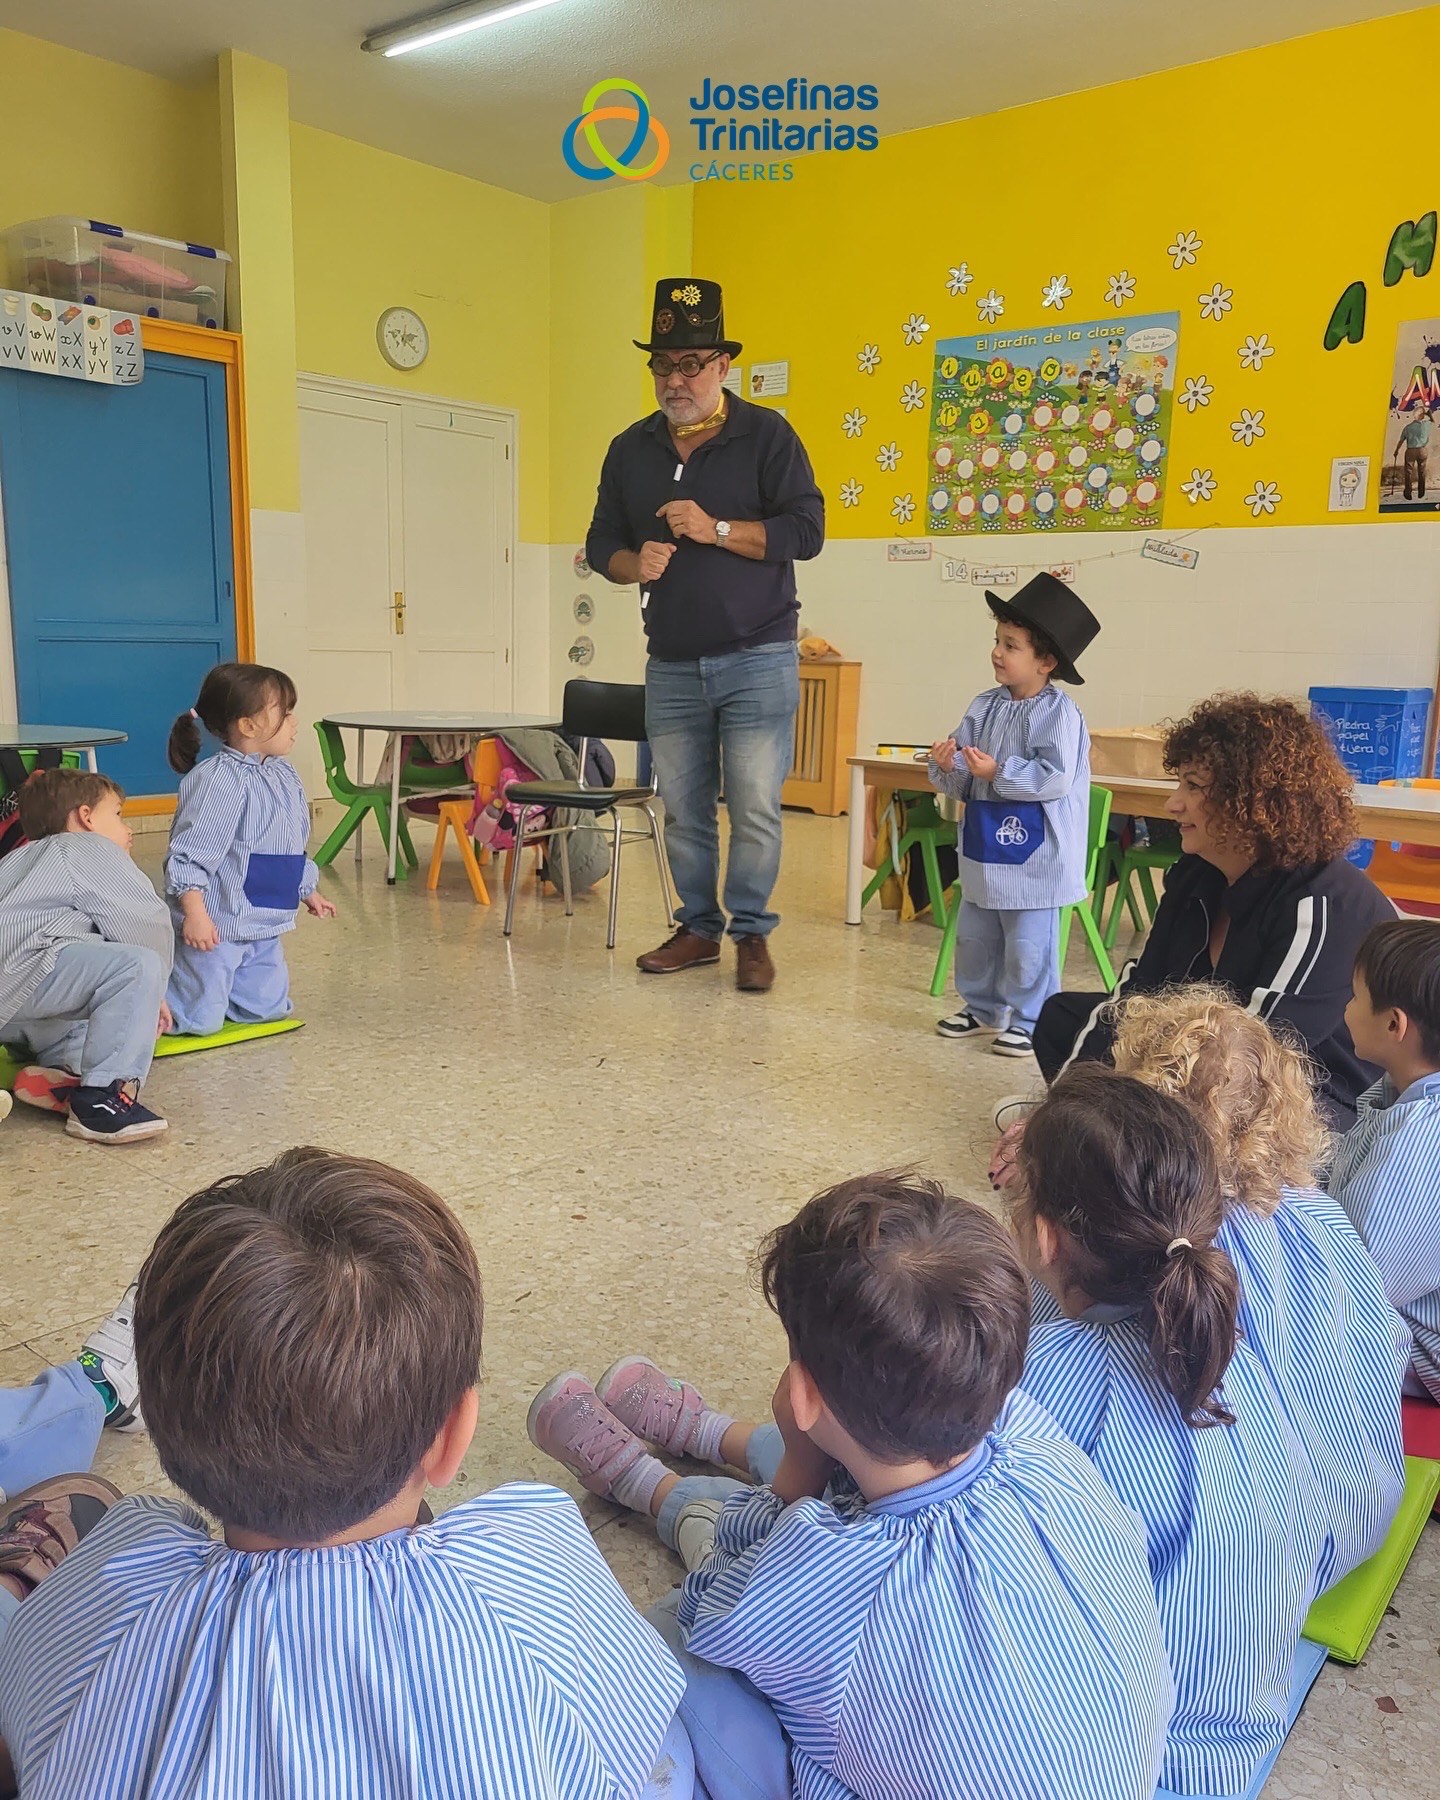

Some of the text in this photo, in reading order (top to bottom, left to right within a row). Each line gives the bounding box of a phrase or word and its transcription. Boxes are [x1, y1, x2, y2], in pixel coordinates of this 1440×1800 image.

[976, 340, 988, 351] El
[993, 335, 1037, 351] jardín
[1043, 333, 1062, 344] de
[1068, 330, 1081, 341] la
[1087, 326, 1125, 338] clase
[945, 561, 968, 579] 14
[1337, 732, 1369, 742] papel
[1340, 743, 1374, 754] tijera
